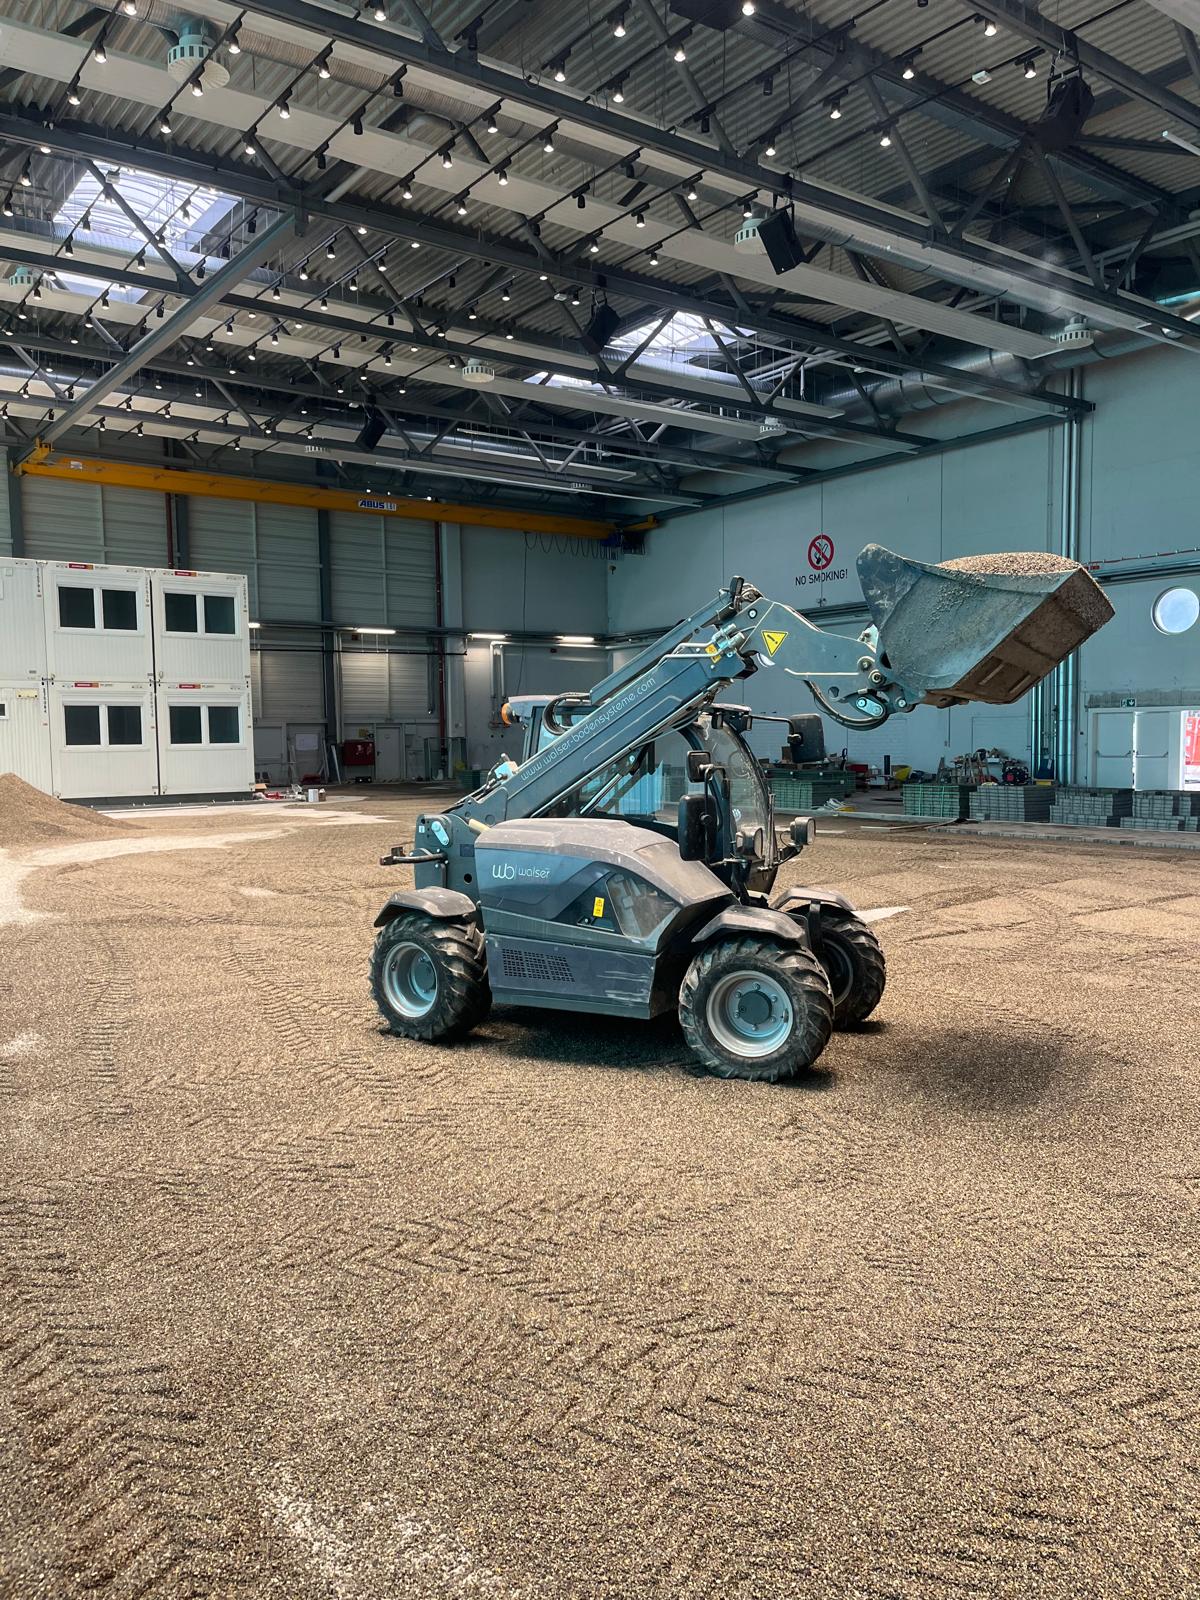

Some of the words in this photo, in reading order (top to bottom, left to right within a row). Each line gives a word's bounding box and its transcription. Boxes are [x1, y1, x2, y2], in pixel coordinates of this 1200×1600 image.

[360, 500, 384, 509] ABUS
[795, 575, 806, 586] NO
[808, 568, 848, 584] SMOKING!
[520, 676, 656, 781] www.walser-bodensysteme.com
[518, 866, 550, 879] walser
